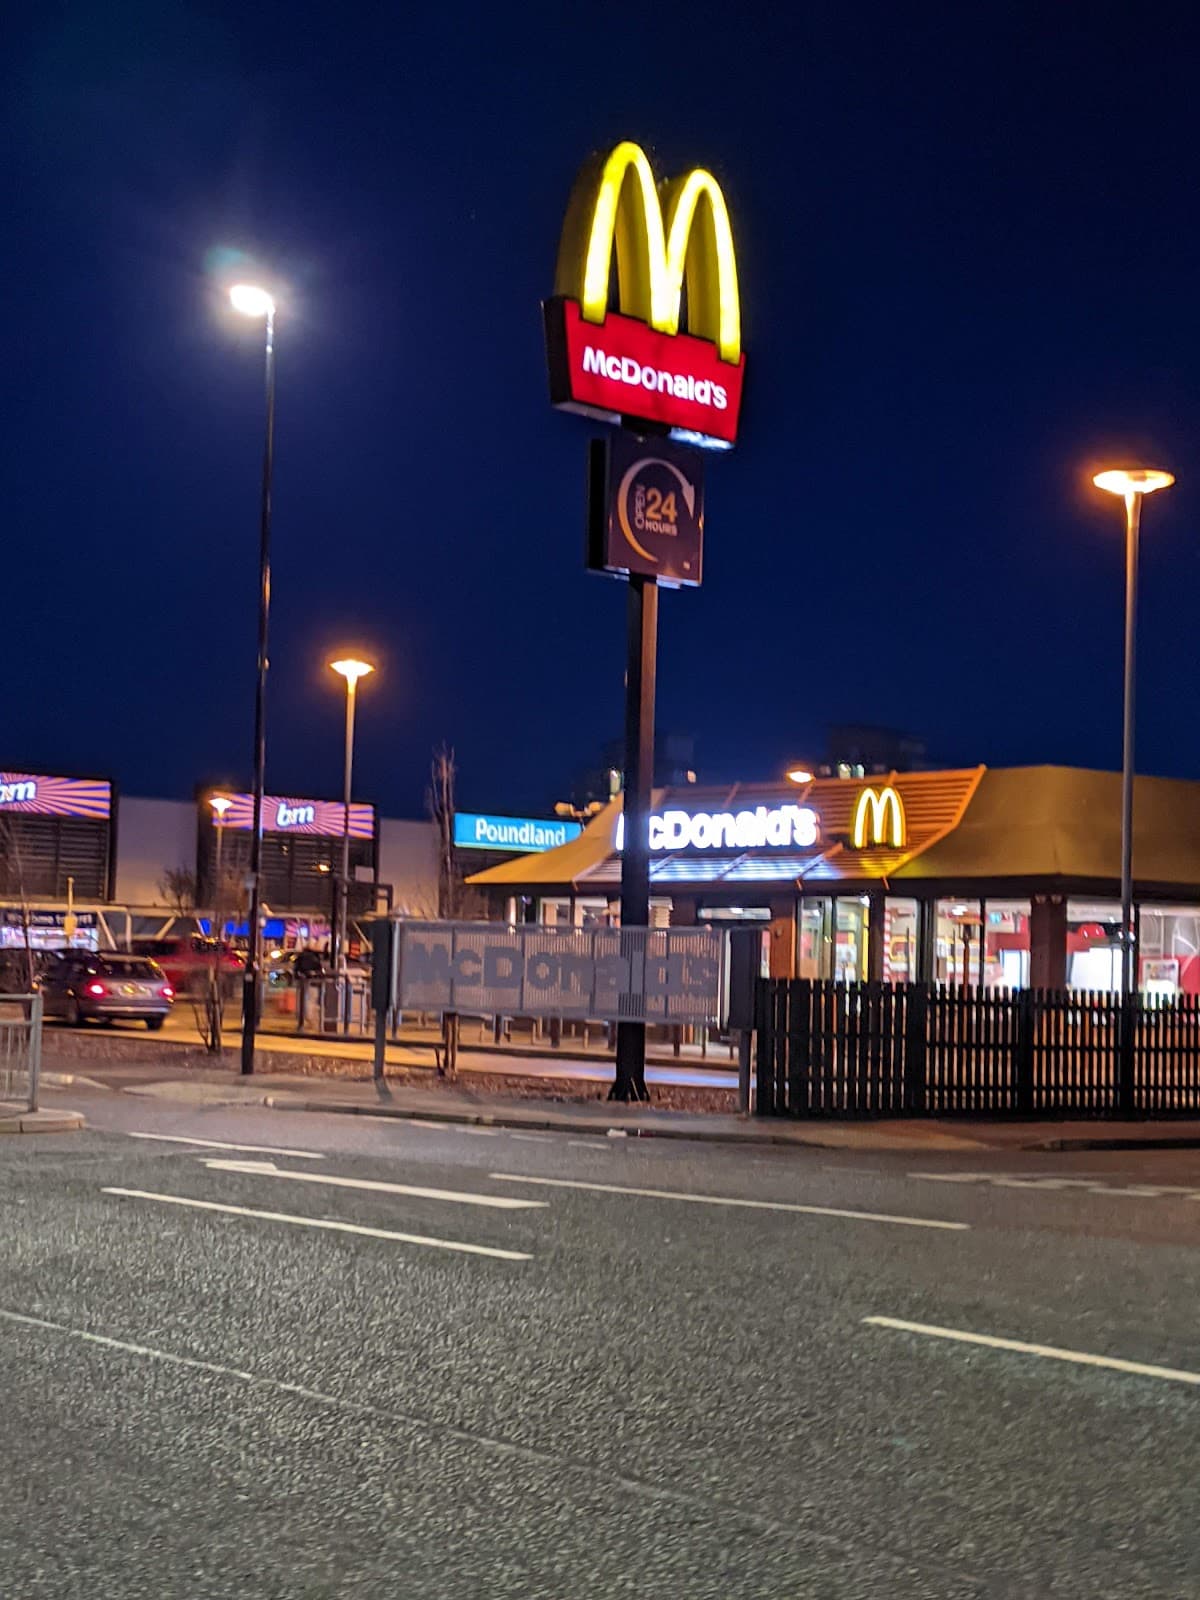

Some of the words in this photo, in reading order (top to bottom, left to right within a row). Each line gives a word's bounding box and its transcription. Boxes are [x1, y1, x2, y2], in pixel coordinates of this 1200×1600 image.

[582, 346, 728, 410] McDonald's
[645, 487, 677, 524] 24
[645, 520, 678, 537] HOURS
[475, 817, 566, 847] Poundland
[615, 805, 817, 850] cDonald's
